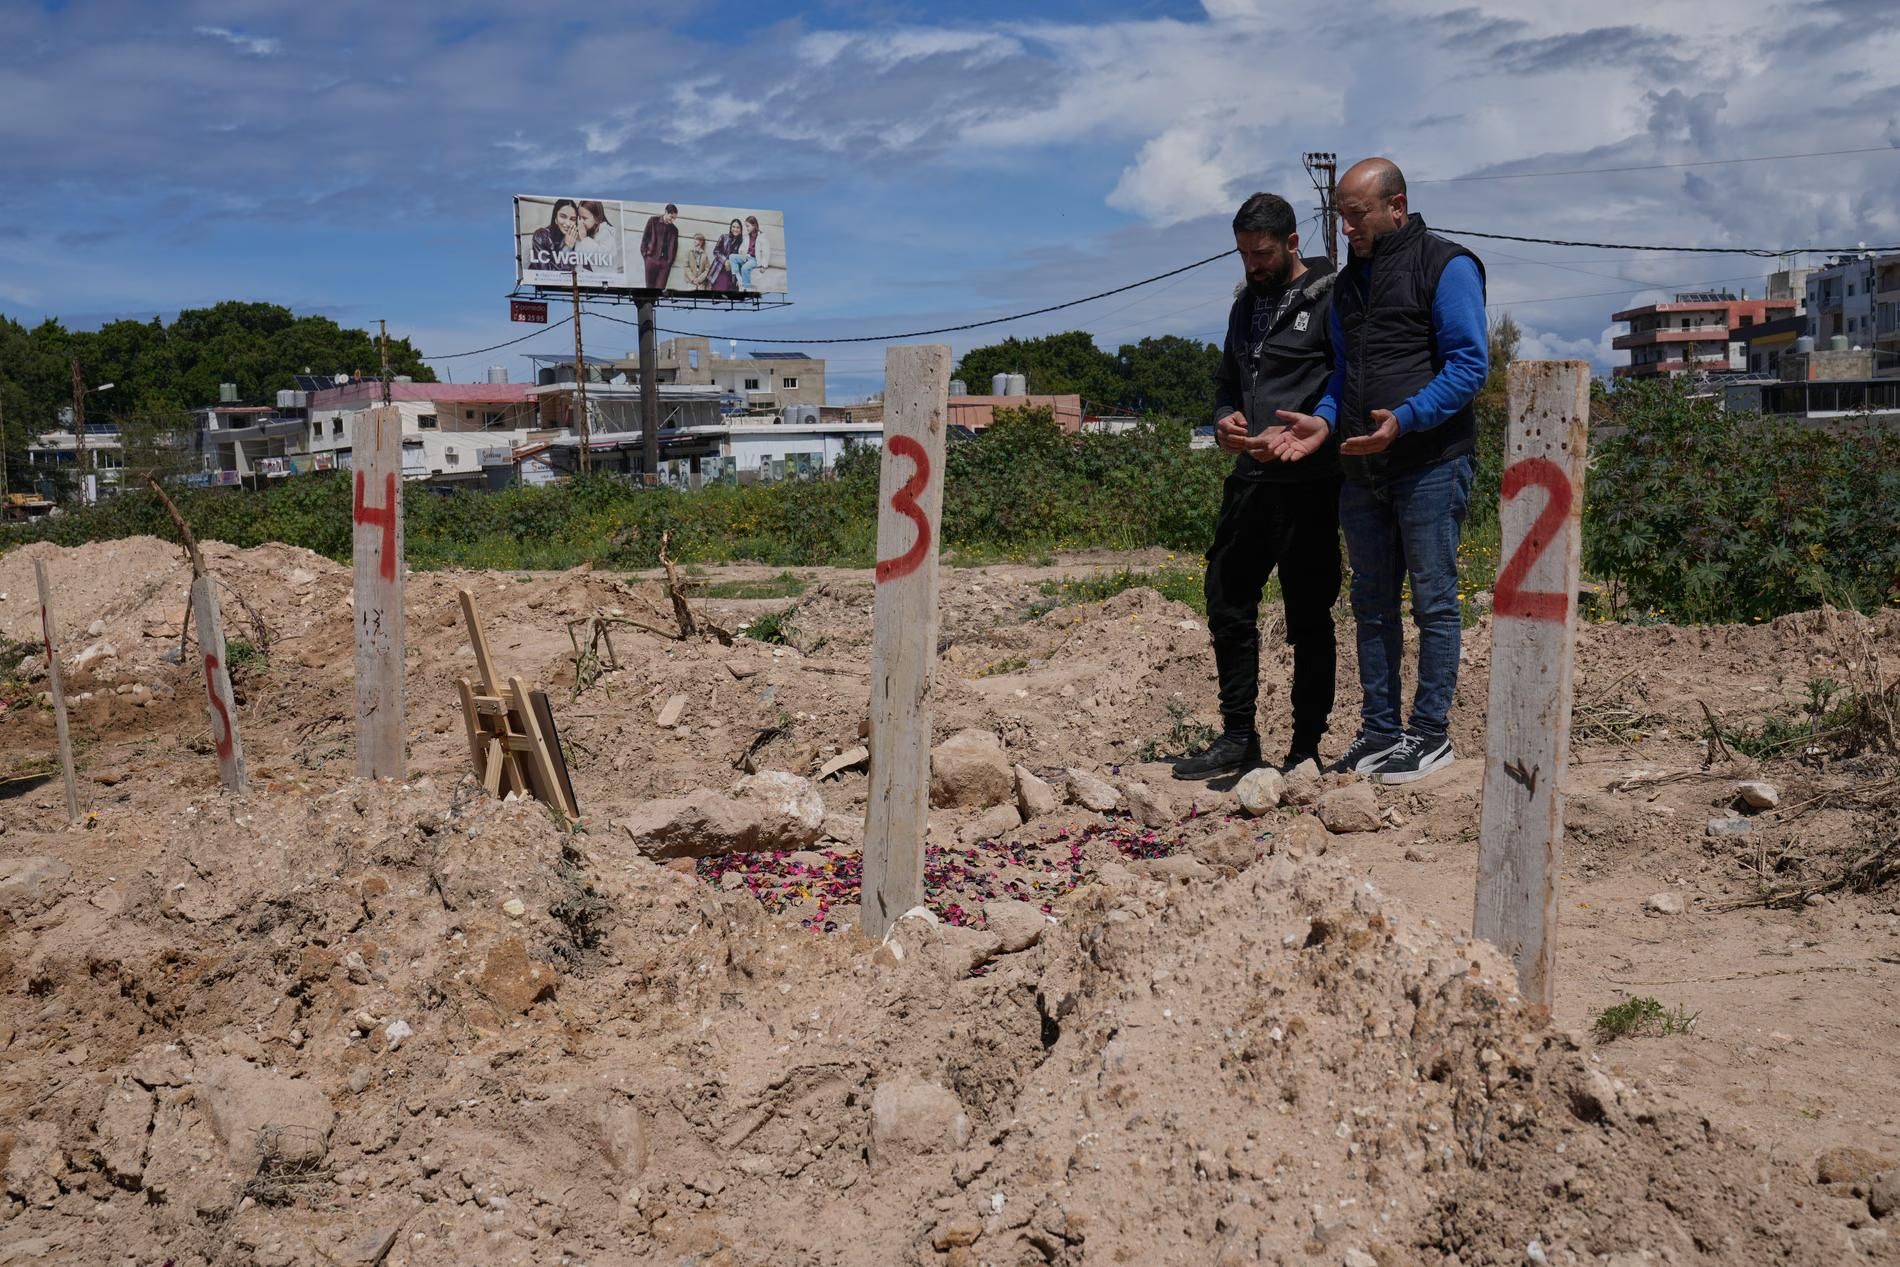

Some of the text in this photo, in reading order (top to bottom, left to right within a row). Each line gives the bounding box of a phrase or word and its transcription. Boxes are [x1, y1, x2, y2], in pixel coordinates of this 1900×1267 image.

[529, 249, 551, 264] LC
[354, 470, 397, 583] 4
[875, 435, 932, 583] 3
[1493, 457, 1575, 624] 2
